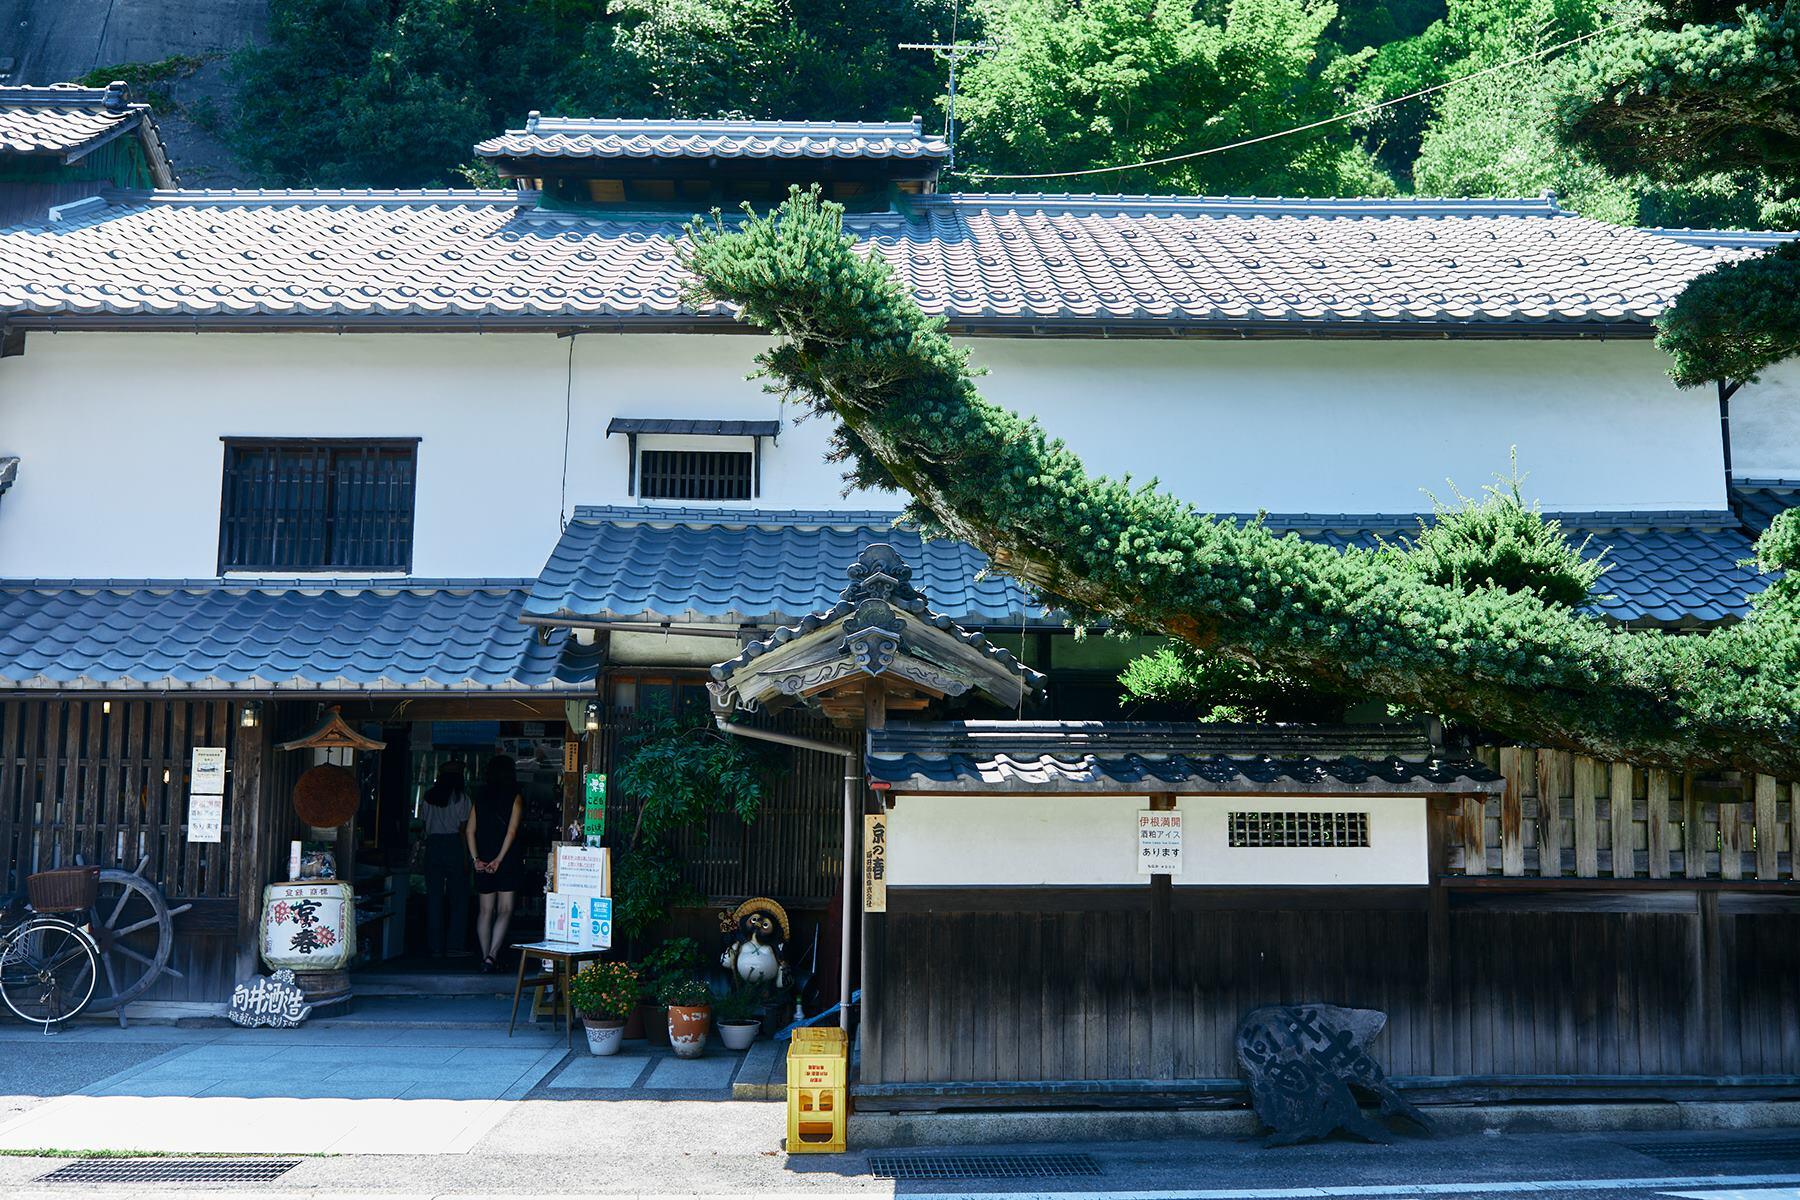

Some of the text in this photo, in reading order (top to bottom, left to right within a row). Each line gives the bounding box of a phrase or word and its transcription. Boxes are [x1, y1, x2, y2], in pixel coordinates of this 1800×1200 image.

[1140, 816, 1181, 828] 伊根満開
[1141, 830, 1181, 839] 酒粕アイス
[872, 822, 885, 880] 京の春
[1142, 848, 1180, 857] あります
[289, 899, 322, 954] 京の春
[232, 979, 312, 1021] 向井酒造
